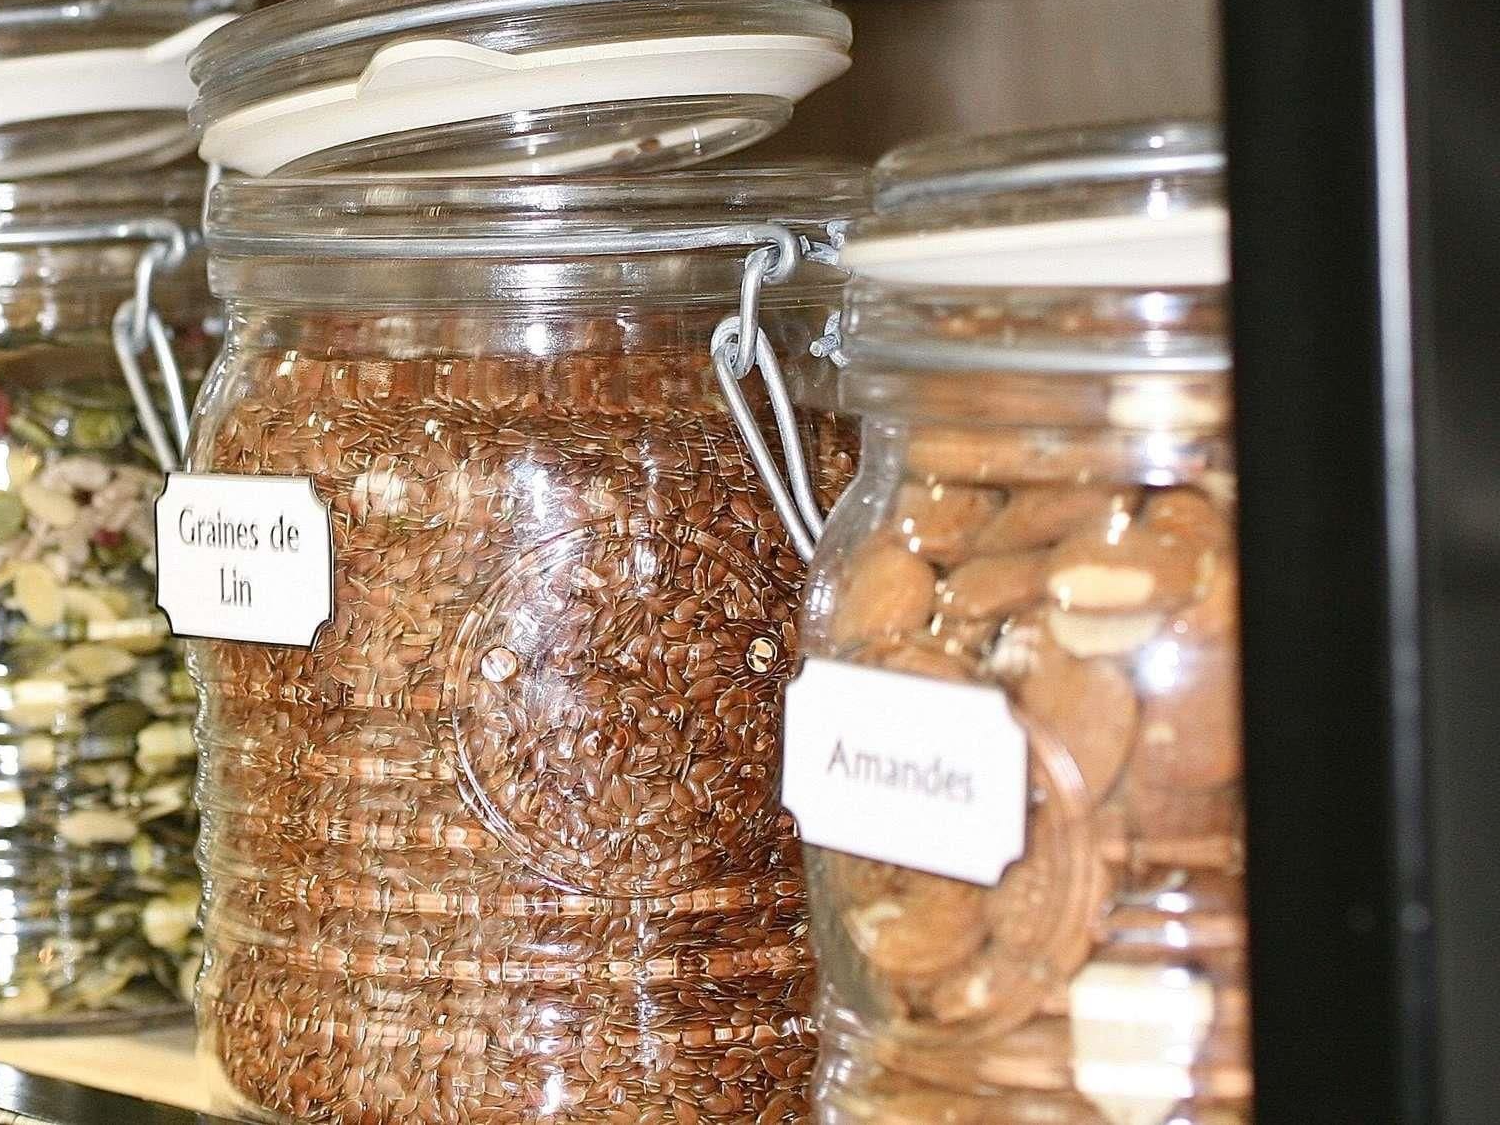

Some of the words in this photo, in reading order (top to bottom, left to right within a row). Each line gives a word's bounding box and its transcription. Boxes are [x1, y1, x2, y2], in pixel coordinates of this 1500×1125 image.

[179, 506, 259, 550] Graines
[270, 512, 300, 552] de
[219, 565, 252, 607] Lin
[826, 737, 974, 804] Amandes
